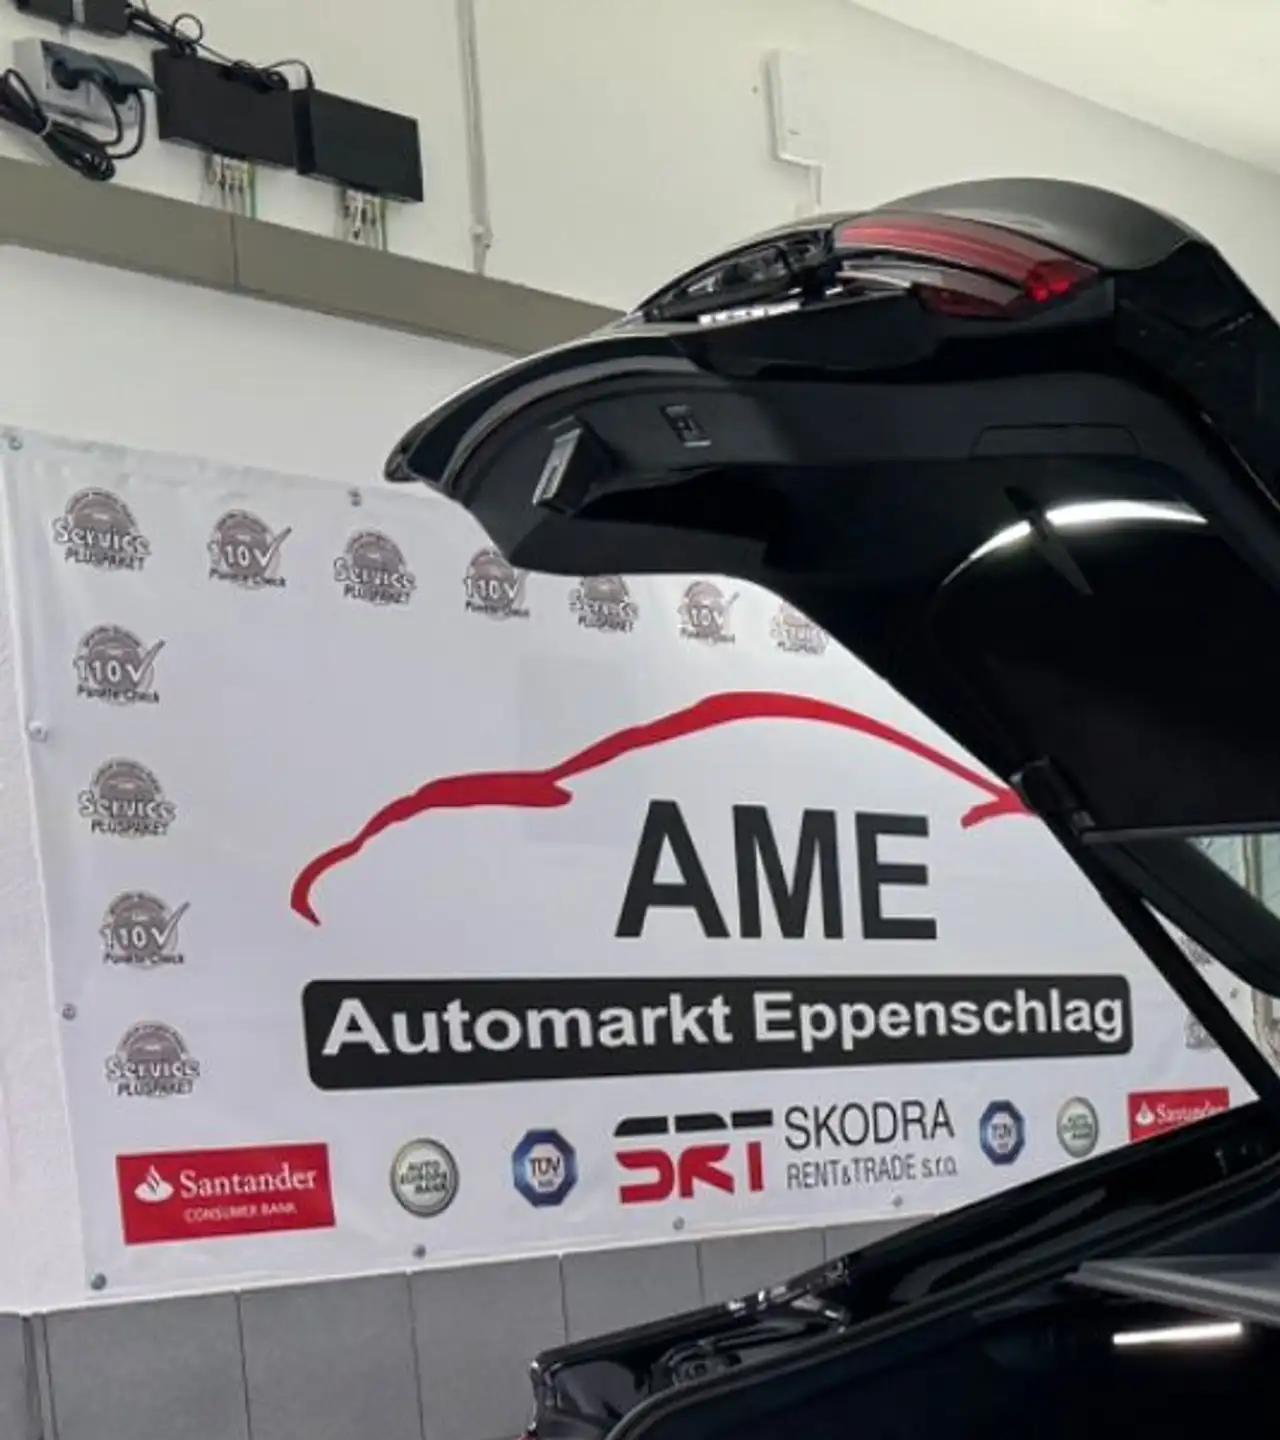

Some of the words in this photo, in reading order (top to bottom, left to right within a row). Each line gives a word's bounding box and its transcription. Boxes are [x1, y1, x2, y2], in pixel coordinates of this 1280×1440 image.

[53, 515, 151, 555] Service
[334, 557, 416, 590] Service
[73, 656, 122, 684] 110
[77, 789, 178, 820] Service
[615, 800, 937, 940] AME
[99, 924, 148, 950] 110
[321, 993, 732, 1058] Automarkt
[754, 988, 1125, 1052] Eppenschlag
[104, 1054, 201, 1081] Service
[784, 1098, 956, 1151] SKODRA
[179, 1161, 317, 1199] Santander
[183, 1203, 258, 1223] CONSUMER
[261, 1201, 298, 1217] BANK
